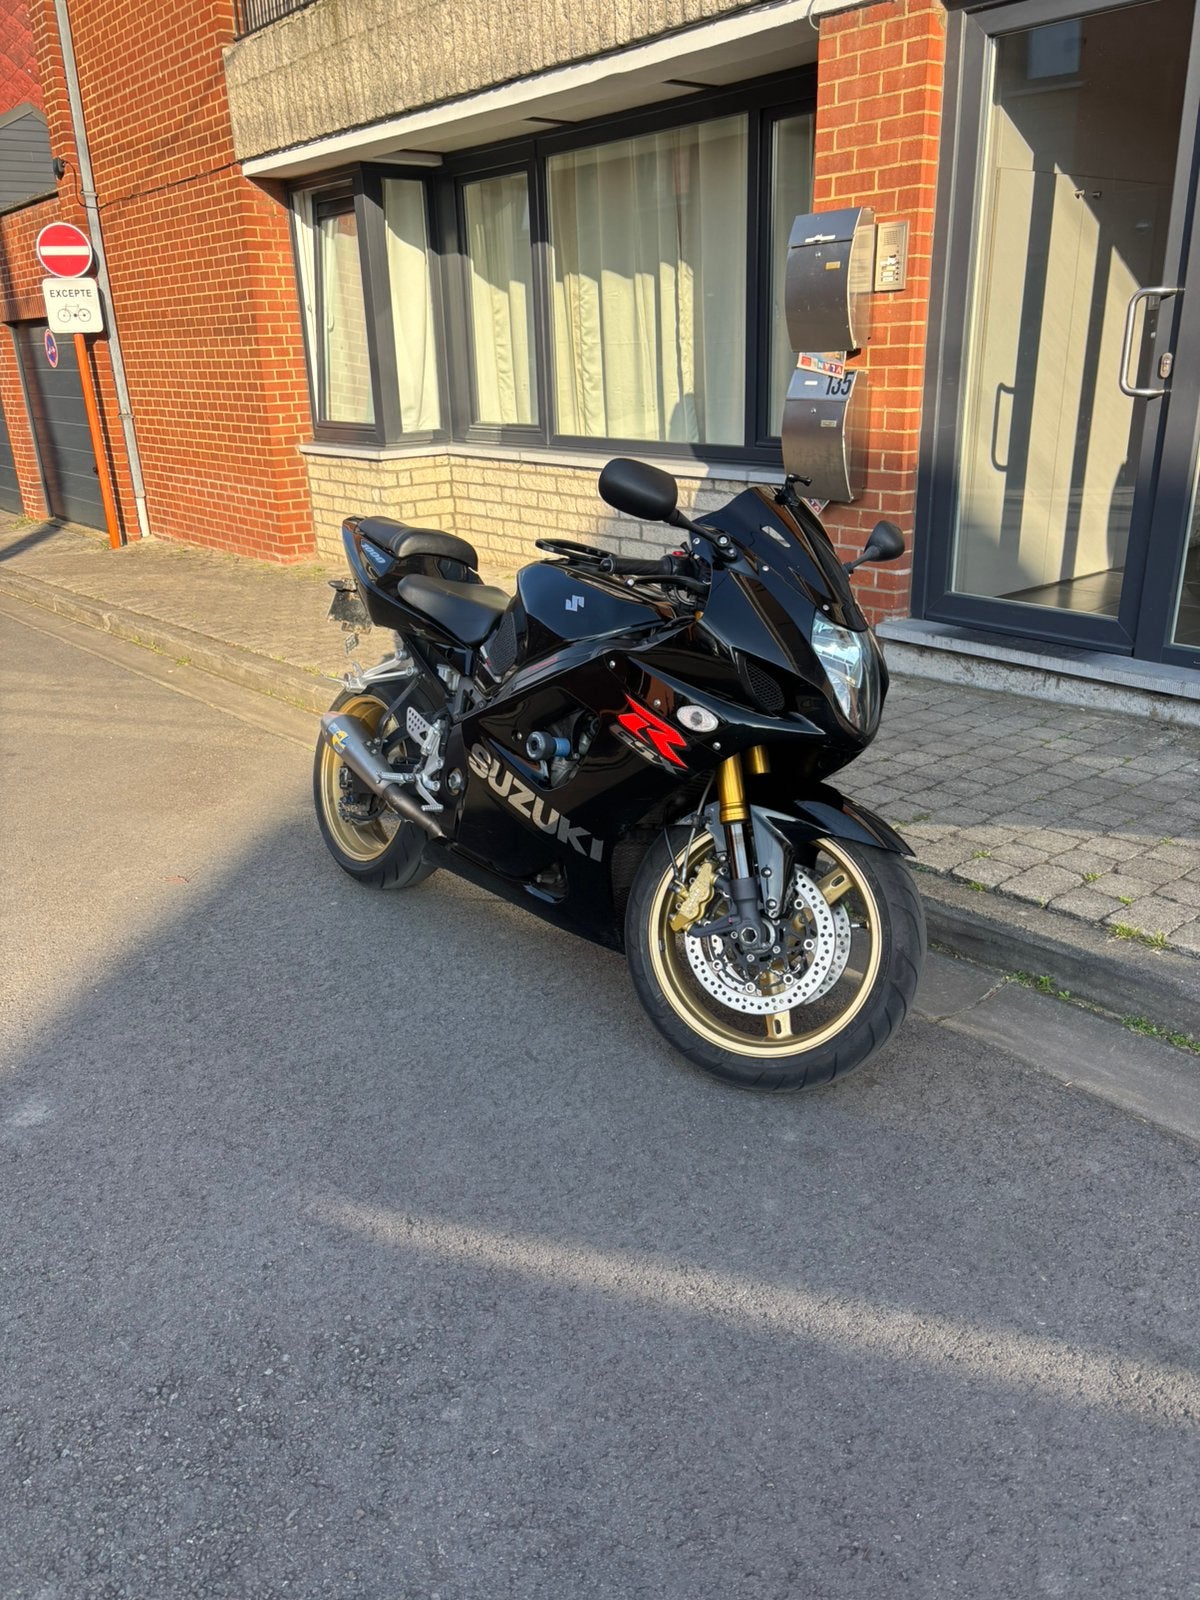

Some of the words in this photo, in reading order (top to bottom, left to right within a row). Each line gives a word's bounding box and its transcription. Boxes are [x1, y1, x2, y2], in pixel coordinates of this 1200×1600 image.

[49, 289, 92, 298] EXCEPTE
[826, 371, 855, 395] 135
[468, 743, 604, 862] SUZUKI
